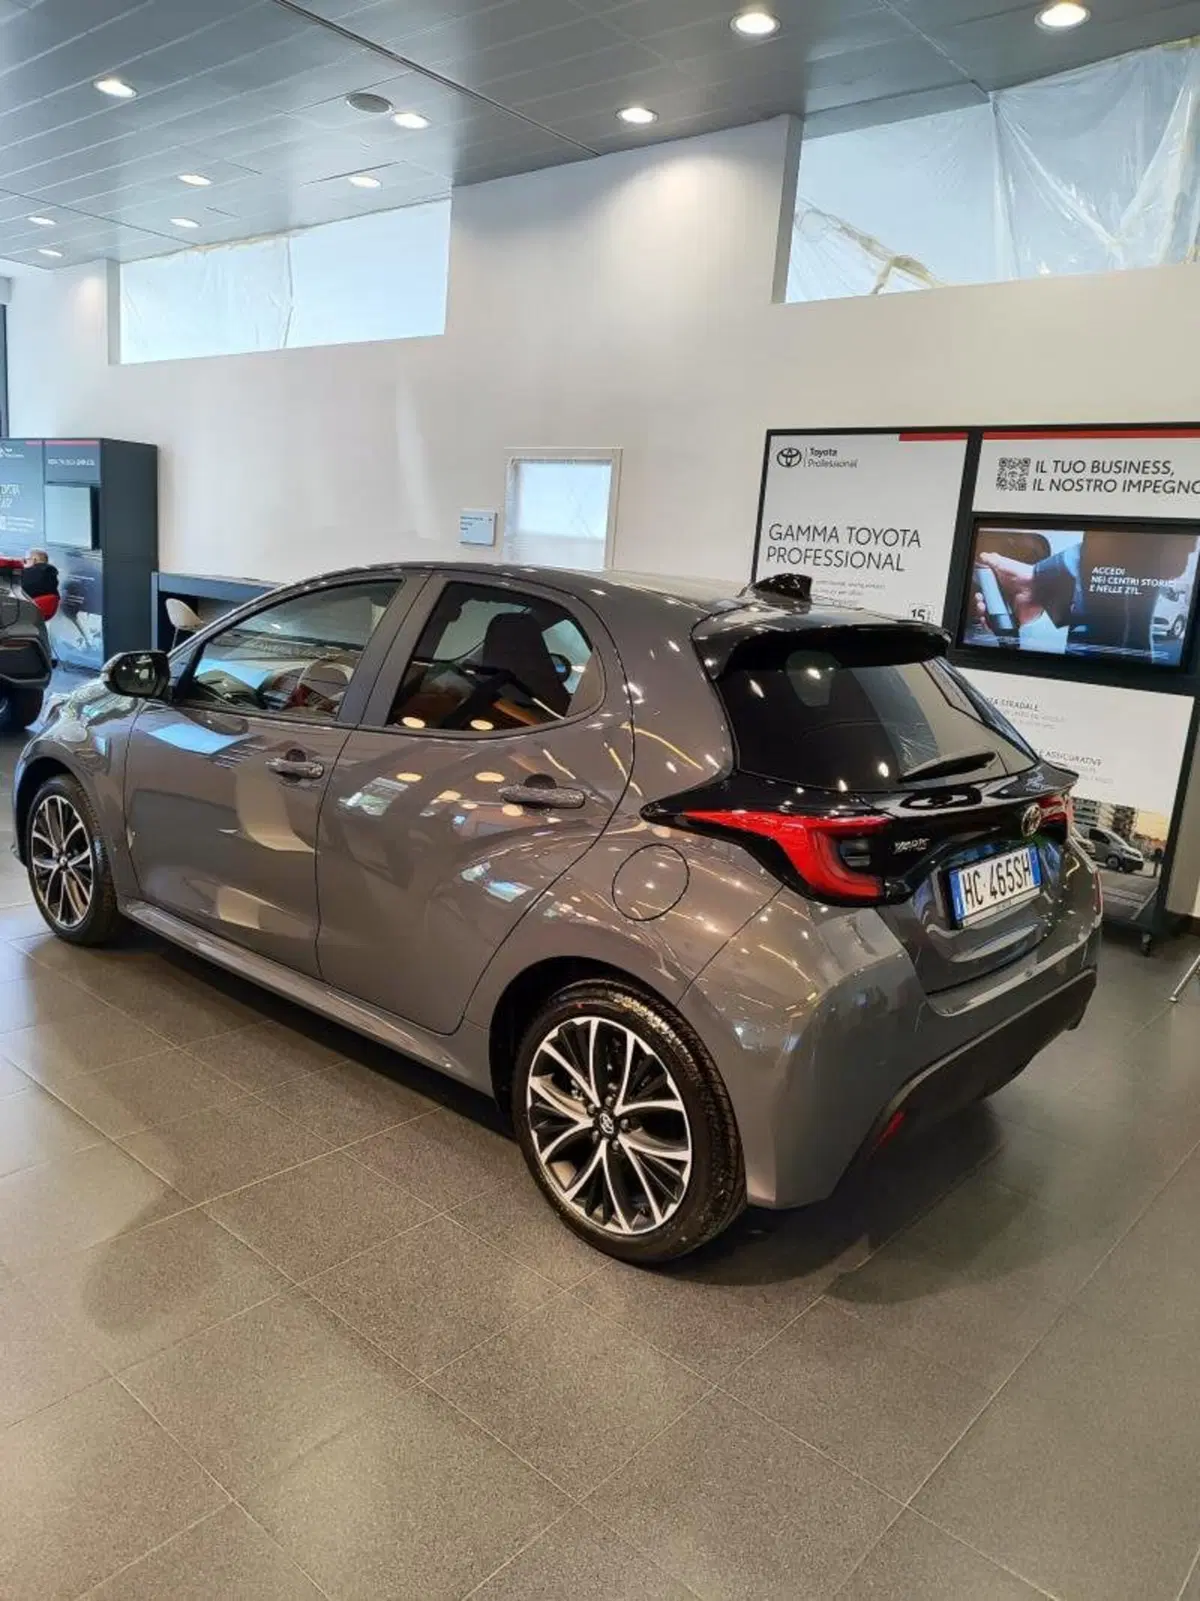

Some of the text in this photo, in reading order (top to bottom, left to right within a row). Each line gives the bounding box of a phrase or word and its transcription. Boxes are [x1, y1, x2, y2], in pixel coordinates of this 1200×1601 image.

[809, 447, 838, 459] Toyota
[807, 459, 858, 469] Professional
[1035, 460, 1175, 477] IL TUO BUSINESS,
[1032, 478, 1044, 492] IL
[1049, 478, 1118, 493] NOSTRO
[768, 523, 921, 548] GAMMA TOYOTA
[766, 546, 905, 572] PROFESSIONAL
[962, 852, 1032, 908] HC 465SH
